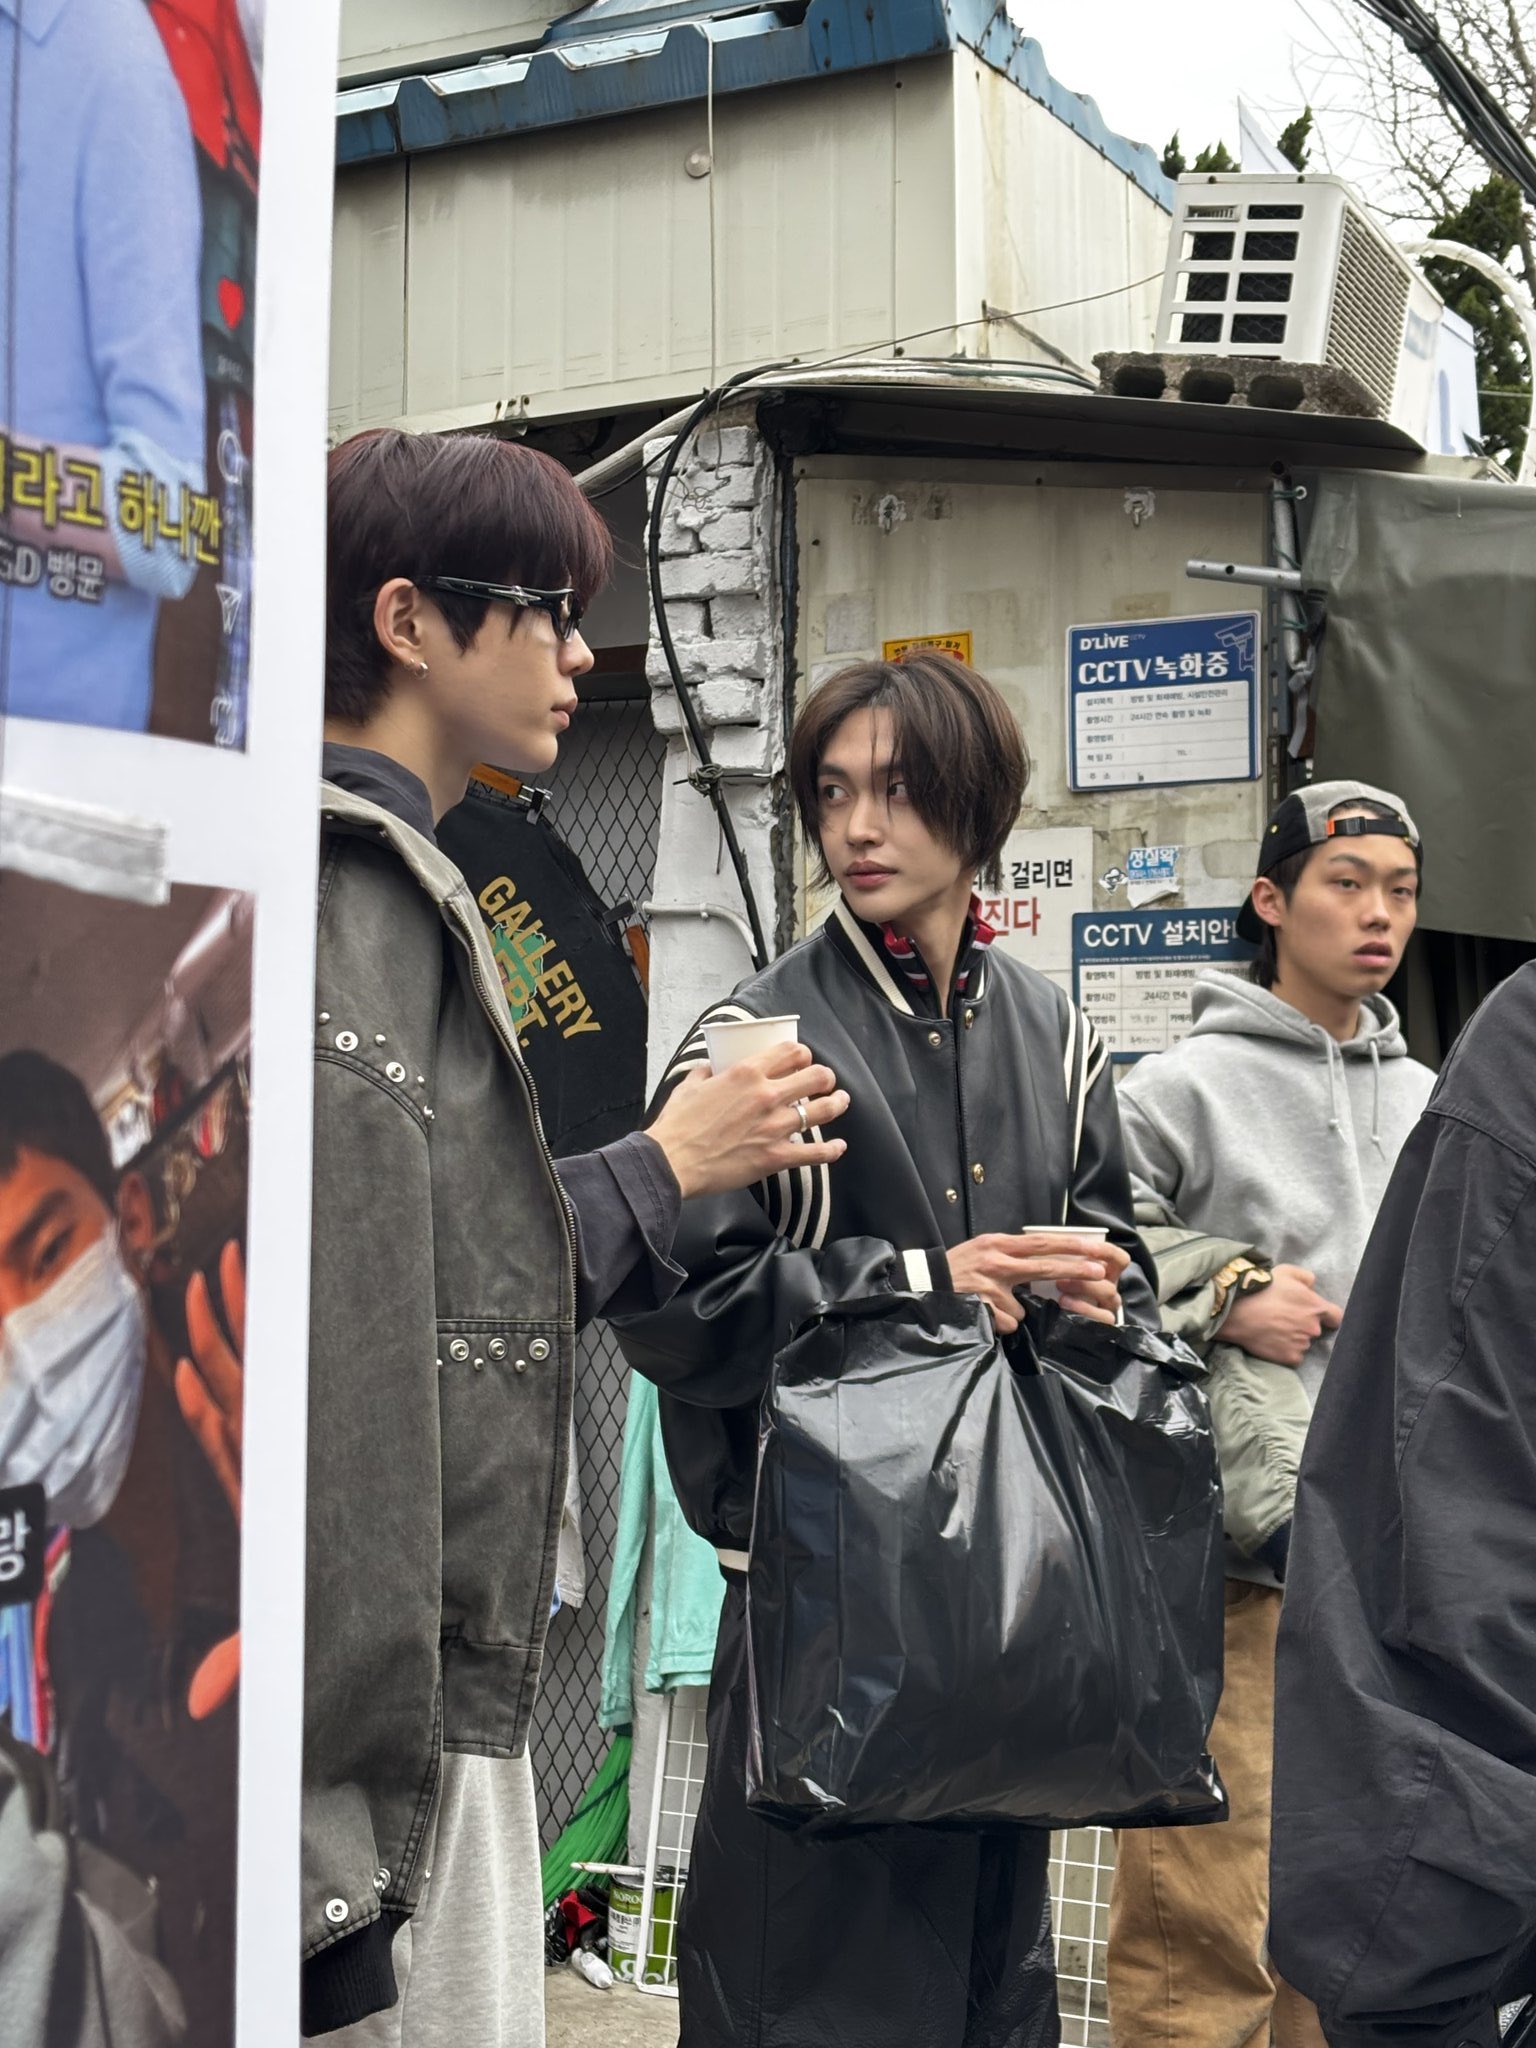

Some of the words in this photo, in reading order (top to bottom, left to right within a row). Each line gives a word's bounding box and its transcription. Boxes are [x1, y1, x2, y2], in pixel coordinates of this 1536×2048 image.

[0, 438, 104, 527] 라고
[118, 473, 221, 565] 하니깐
[1079, 658, 1152, 685] CCTV
[1154, 651, 1230, 681] 녹화중
[1011, 859, 1073, 890] 걸리면
[984, 897, 1041, 937] 진다
[1083, 923, 1153, 947] CCTV
[478, 875, 602, 1039] GALLERY
